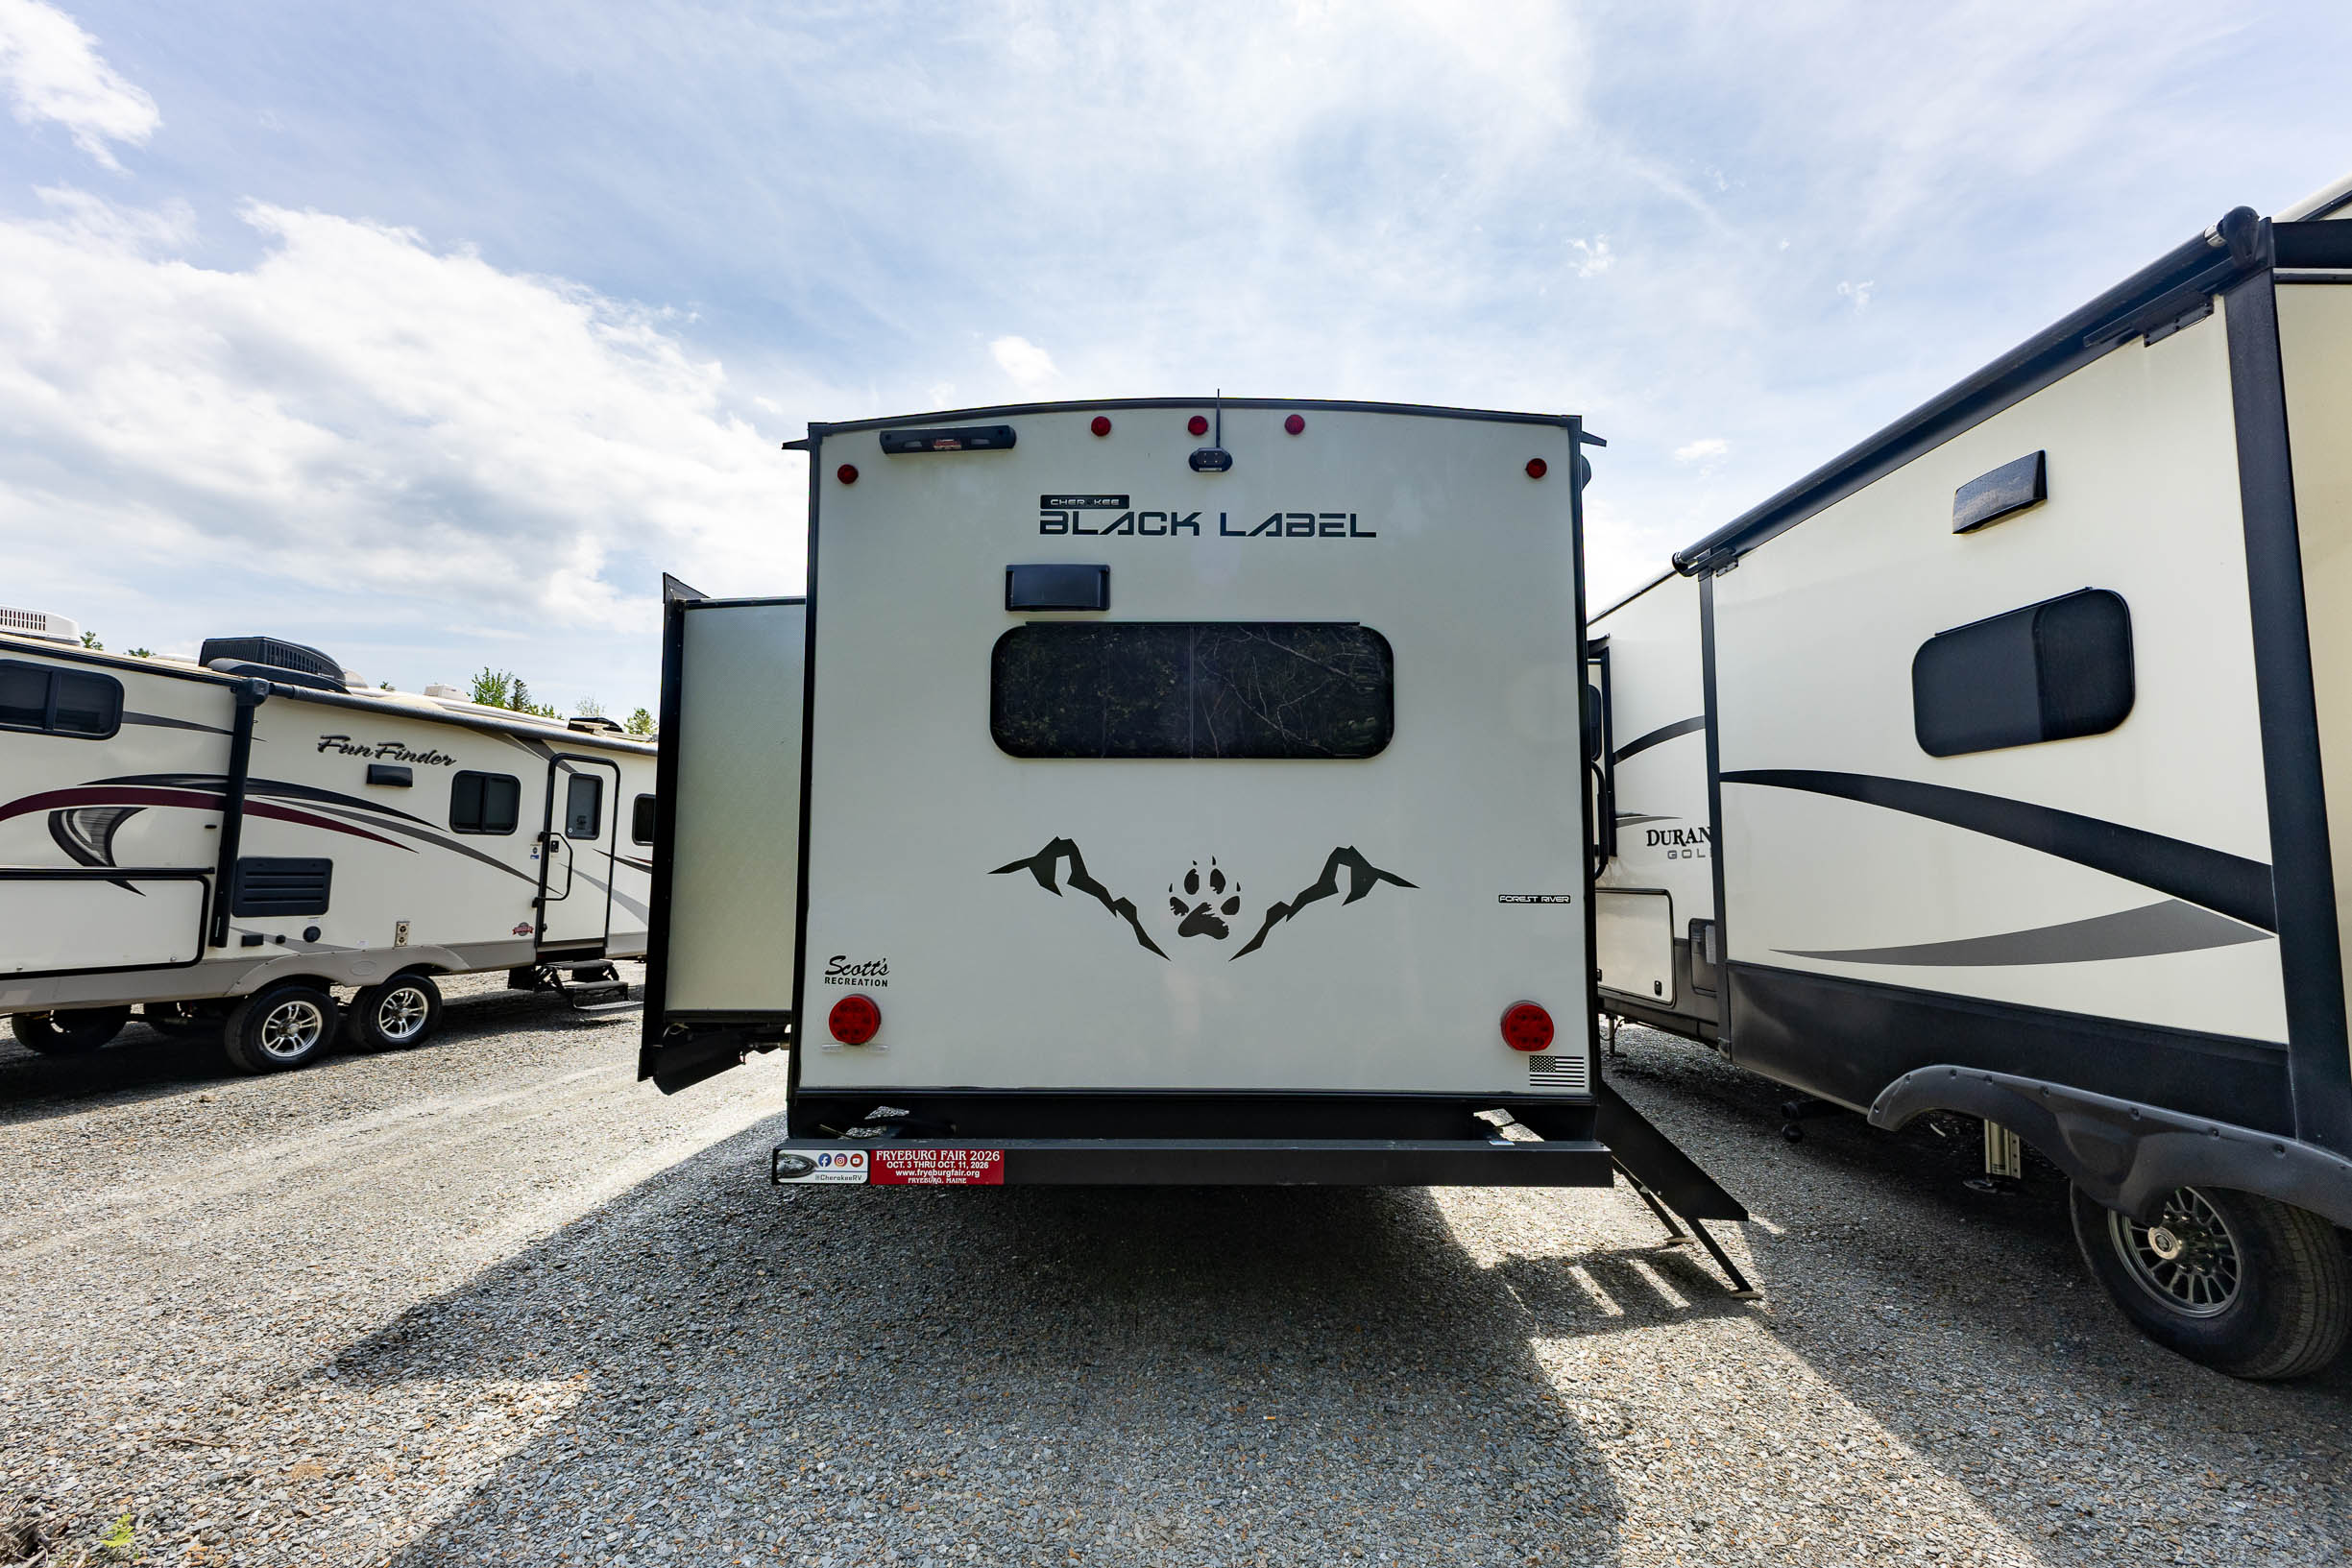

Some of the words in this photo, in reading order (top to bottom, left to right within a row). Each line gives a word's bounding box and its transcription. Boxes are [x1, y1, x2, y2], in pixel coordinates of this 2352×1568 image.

[1050, 498, 1120, 507] CHERKEE
[1040, 511, 1202, 536] BLACK
[1220, 512, 1376, 538] LABEL
[317, 734, 374, 758] Fun
[375, 740, 456, 767] Finder
[1667, 848, 1710, 860] GOL
[824, 955, 889, 977] Scott's
[824, 977, 888, 987] RECREATION
[876, 1150, 936, 1161] FRYEBURG
[940, 1150, 967, 1161] FAIR
[970, 1150, 1001, 1161] 2026
[958, 1161, 969, 1170] 11,
[895, 1169, 981, 1178] www.fryeburgfair.org
